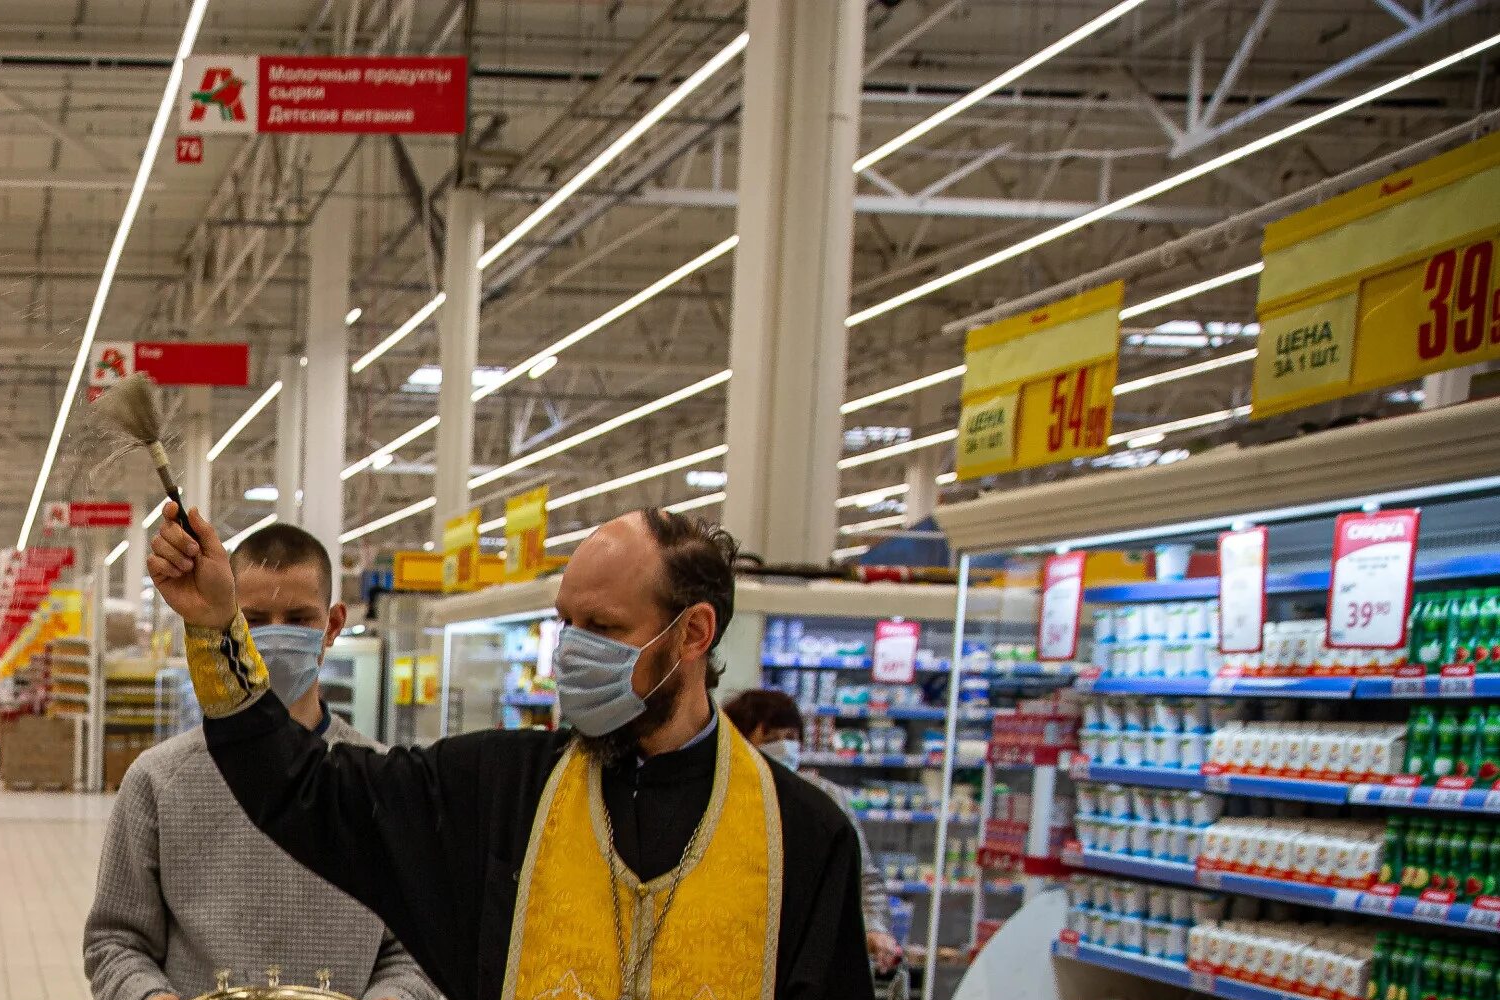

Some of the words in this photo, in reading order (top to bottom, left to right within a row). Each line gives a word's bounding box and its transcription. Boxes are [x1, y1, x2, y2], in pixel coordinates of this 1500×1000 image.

[268, 65, 360, 82] Молочные
[364, 68, 452, 87] продукты
[266, 105, 339, 125] Детское
[1276, 321, 1333, 356] ЦЕНА
[1047, 367, 1088, 453] 54
[1346, 601, 1373, 628] 39
